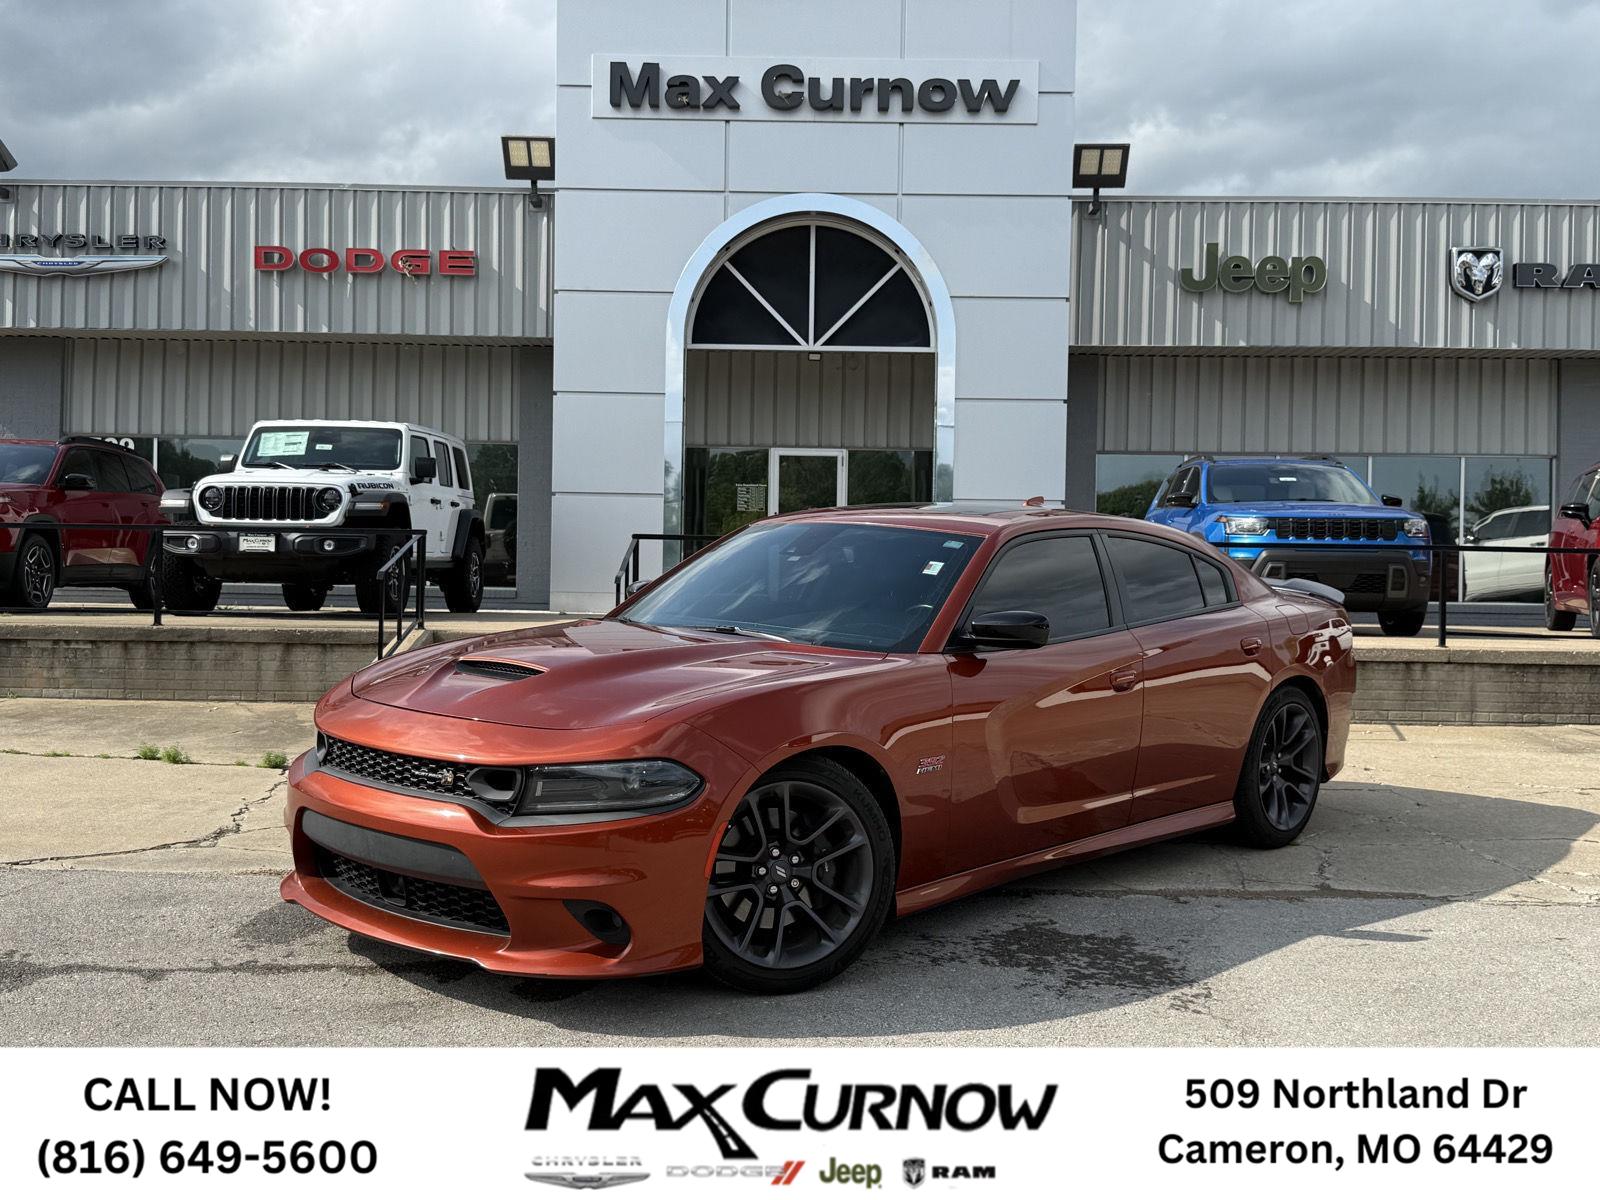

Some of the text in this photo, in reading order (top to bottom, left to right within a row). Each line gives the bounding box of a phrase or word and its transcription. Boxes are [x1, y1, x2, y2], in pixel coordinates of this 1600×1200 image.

[609, 61, 1020, 113] Max Curnow
[254, 245, 476, 276] DODGE
[1180, 242, 1328, 303] Jeep
[356, 482, 394, 490] RUBICON
